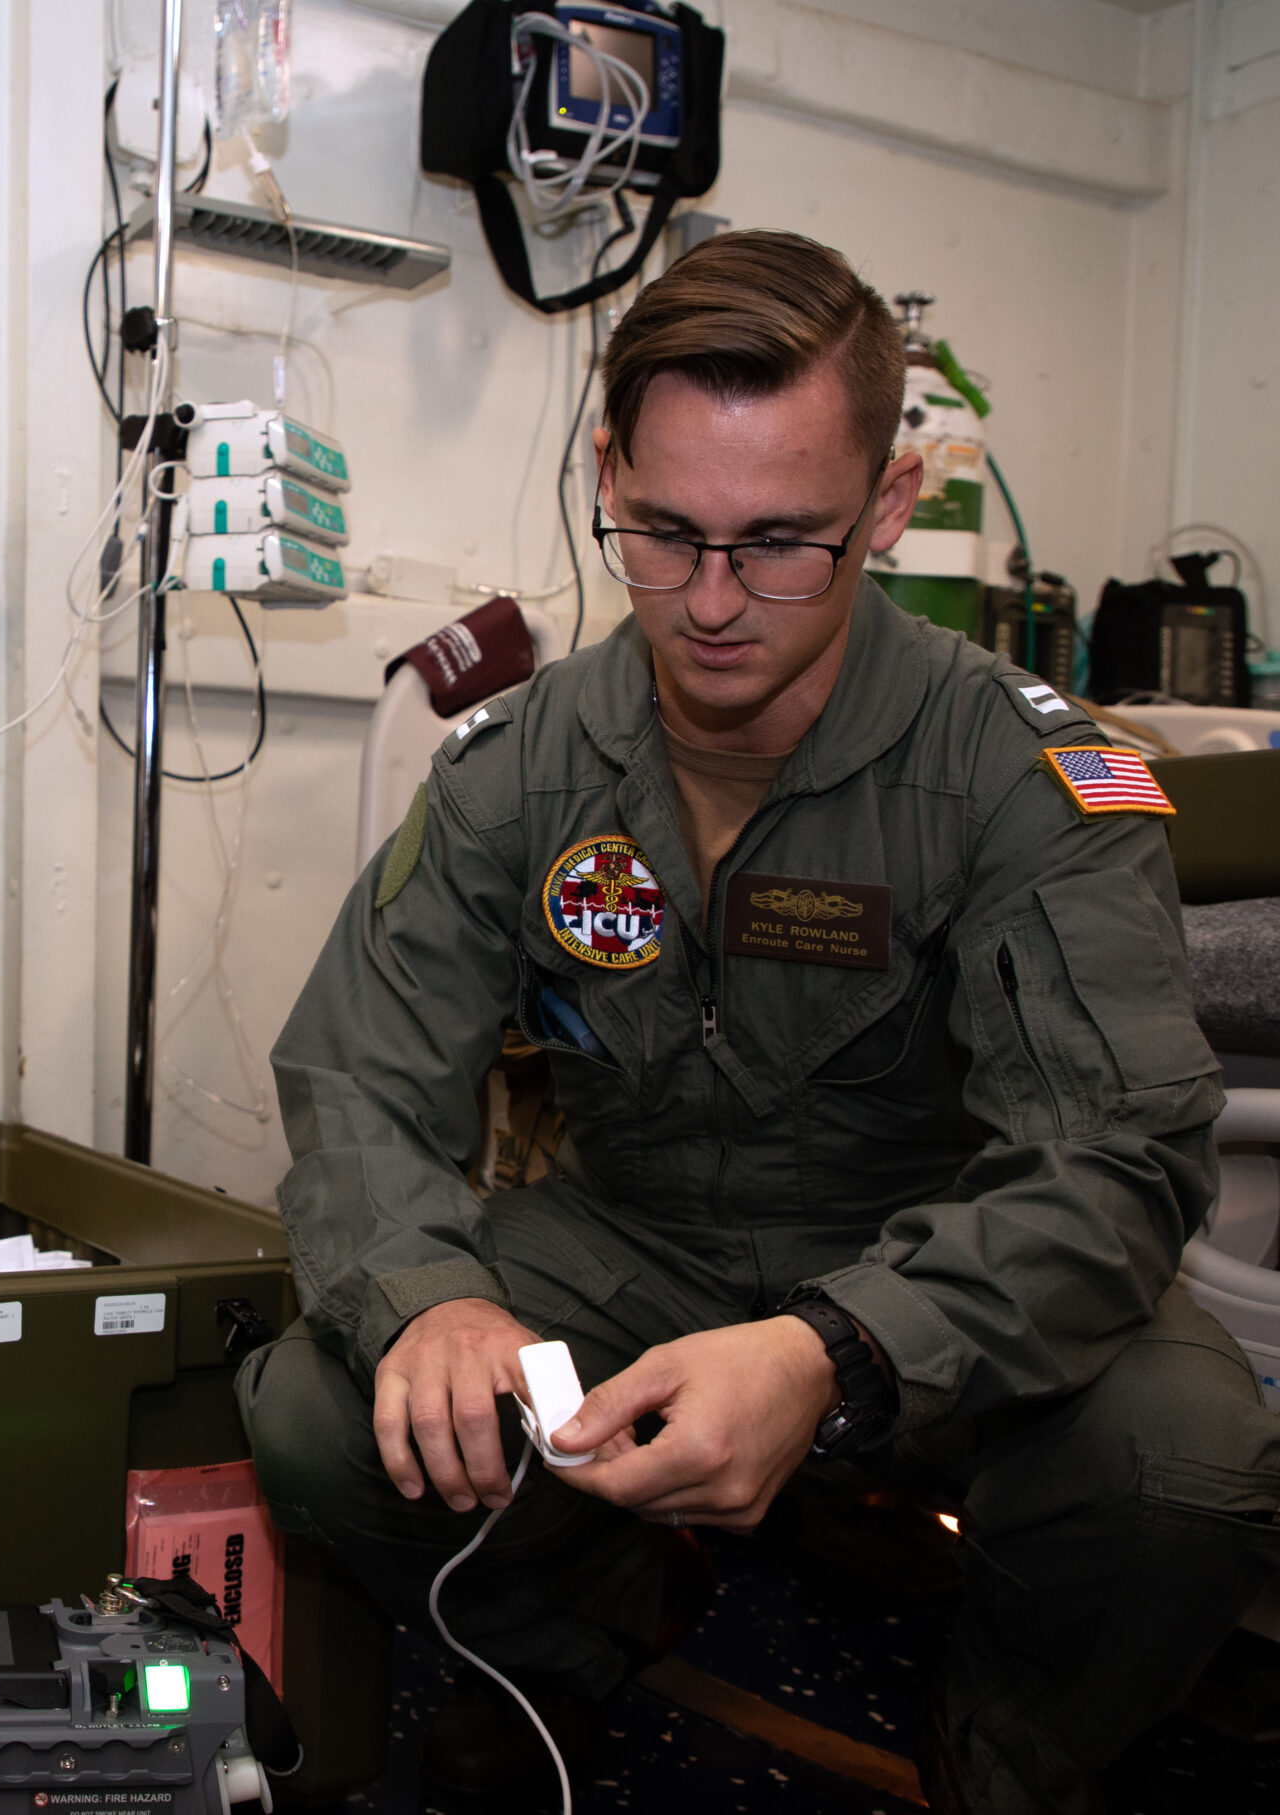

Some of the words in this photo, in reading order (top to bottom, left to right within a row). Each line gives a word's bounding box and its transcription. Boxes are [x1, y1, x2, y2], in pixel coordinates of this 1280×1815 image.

[551, 869, 567, 897] NAVAL
[563, 845, 598, 873] MEDICAL
[601, 843, 634, 856] CENTER
[582, 910, 640, 940] ICU
[751, 921, 785, 934] KYLE
[790, 926, 860, 942] ROWLAND
[559, 928, 608, 961] INTENSIVE
[611, 953, 638, 963] CARE
[640, 937, 662, 956] UNIT
[742, 933, 789, 948] Enroute
[795, 940, 825, 952] Care
[830, 944, 868, 956] Nurse
[223, 1533, 244, 1624] ENCLOSED
[50, 1793, 102, 1804] WARNING:
[105, 1793, 128, 1803] FIRE
[130, 1792, 172, 1803] HAZARD
